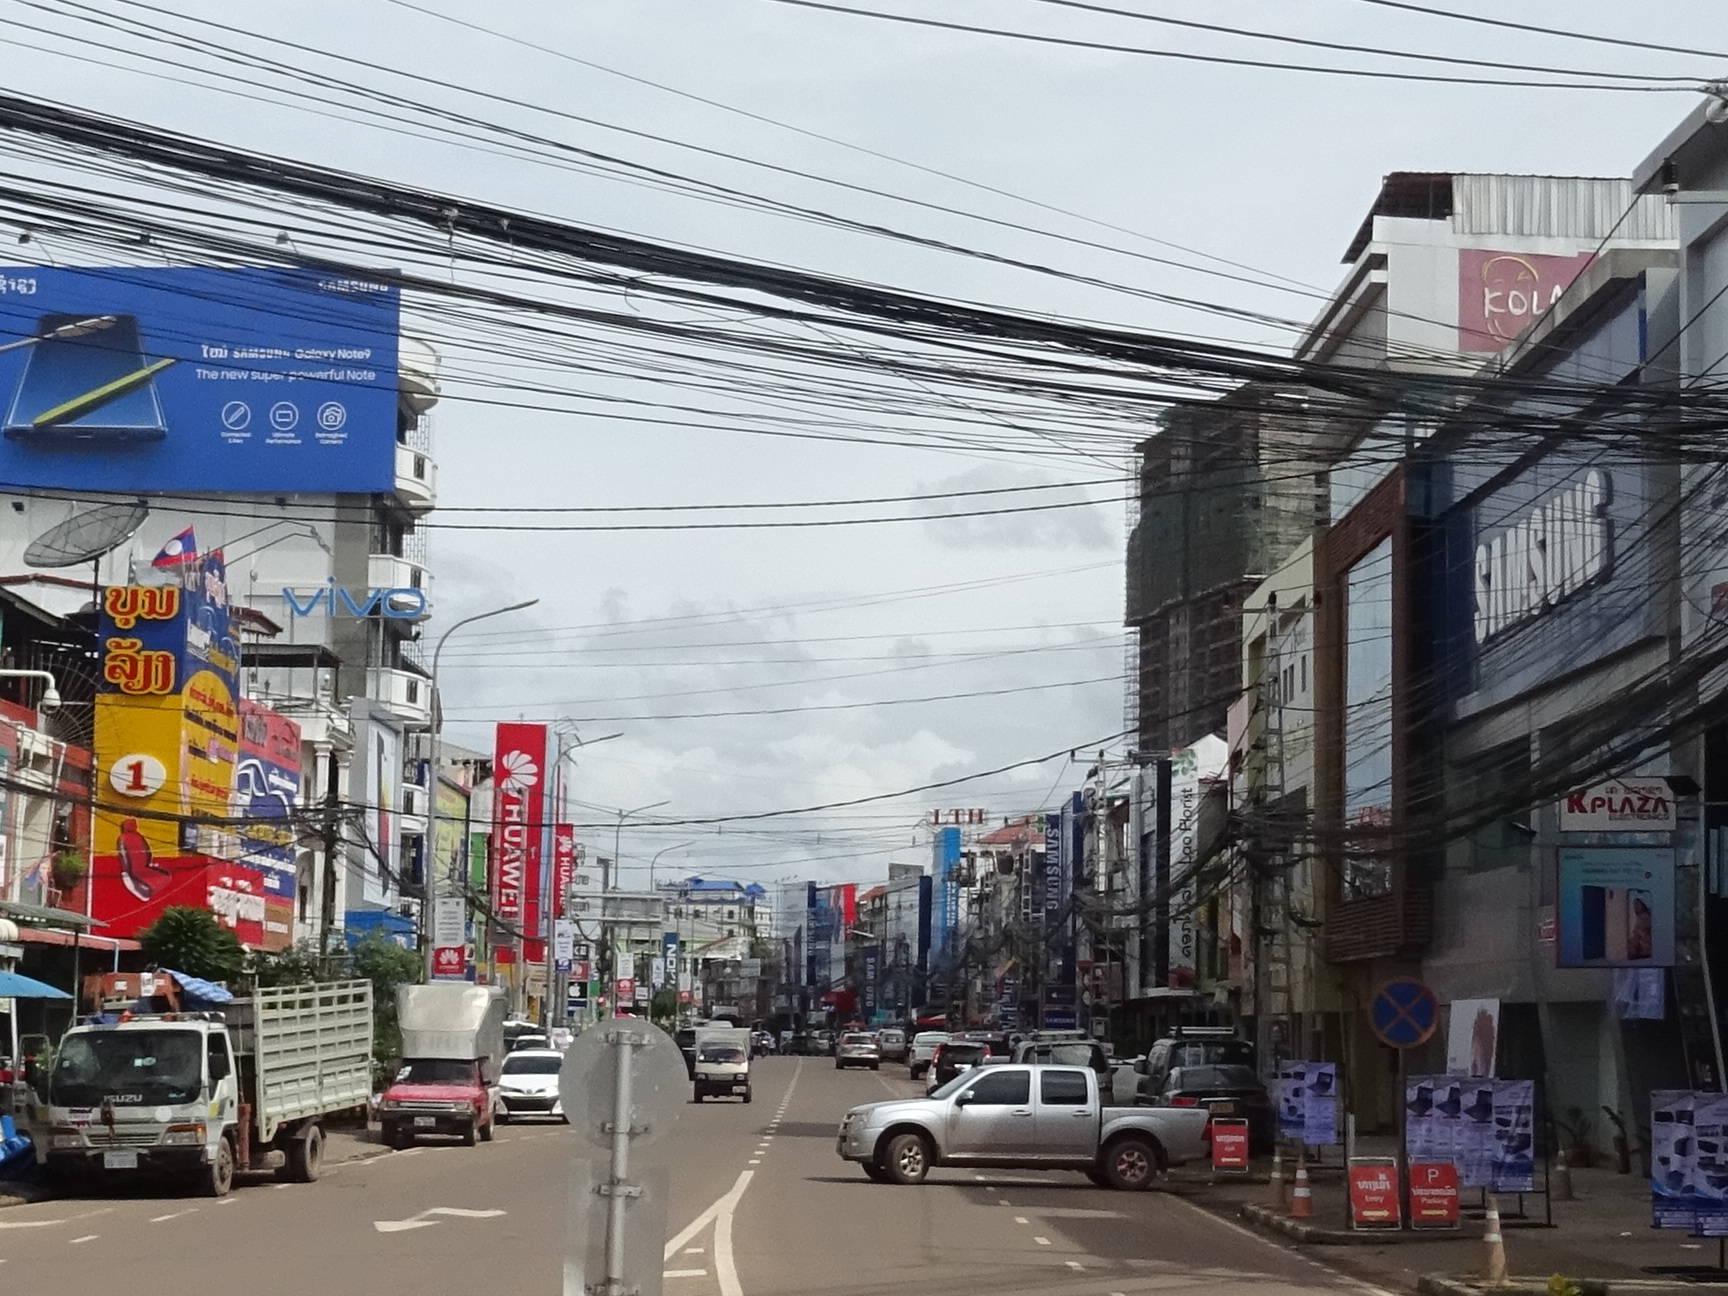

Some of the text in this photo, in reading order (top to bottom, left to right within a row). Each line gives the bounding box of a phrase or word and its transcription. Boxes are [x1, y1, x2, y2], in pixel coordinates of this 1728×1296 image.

[318, 280, 388, 294] SAMSUNG
[295, 349, 336, 361] Galaxy
[337, 349, 371, 359] Note9
[196, 369, 376, 383] The new super powerful Note
[1474, 469, 1610, 644] SAMSUNG
[282, 576, 427, 618] vivo
[126, 761, 148, 791] 1
[1178, 788, 1193, 864] Lao Florist
[501, 804, 522, 915] HUAWEI
[1046, 828, 1059, 910] SAMSUNG
[866, 957, 874, 1007] SAMUNG
[104, 1094, 142, 1102] ISUZU
[1427, 1169, 1439, 1183] P
